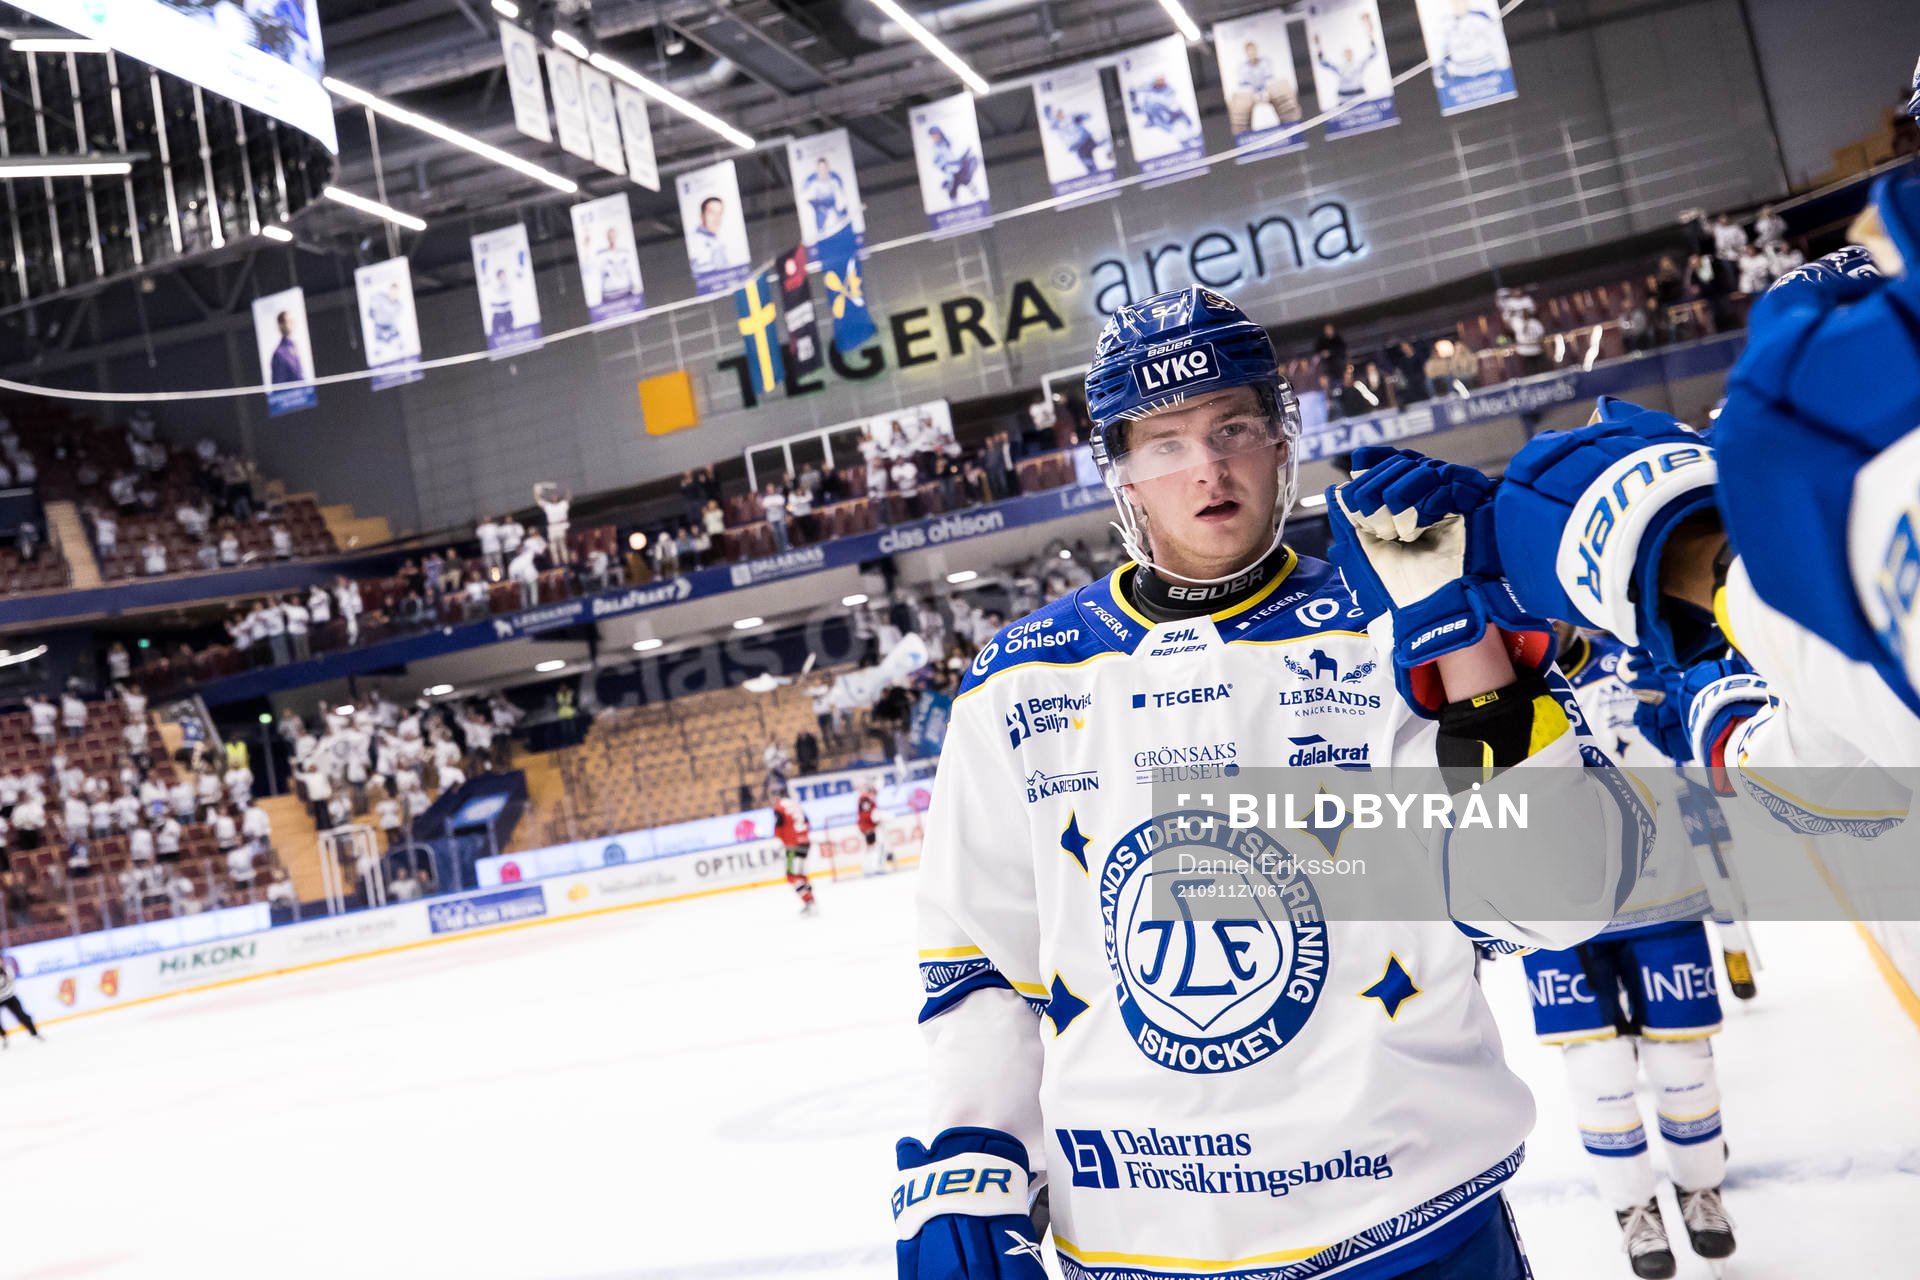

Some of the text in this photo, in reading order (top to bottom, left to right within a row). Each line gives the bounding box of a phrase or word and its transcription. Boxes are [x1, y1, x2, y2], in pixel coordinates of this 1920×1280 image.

[1091, 202, 1364, 315] arena
[1147, 339, 1193, 358] BAUER
[1142, 351, 1208, 390] LYKO
[879, 510, 1004, 553] clas ohlson
[1167, 566, 1265, 600] BAUER
[1250, 591, 1310, 622] TEGERA
[1005, 628, 1080, 653] Ohlson
[1006, 617, 1055, 640] Clas
[1161, 628, 1200, 643] SHL
[1411, 619, 1468, 650] BAUER
[1150, 643, 1208, 656] BAUER
[1280, 687, 1381, 709] LEKSANDS
[1134, 742, 1237, 768] GRÖNSAKS
[1160, 762, 1224, 783] HUSET
[1137, 1017, 1284, 1070] ISHOCKEY
[1113, 1127, 1251, 1157] Dalarnas
[1126, 1149, 1393, 1198] Försäkringsbolag
